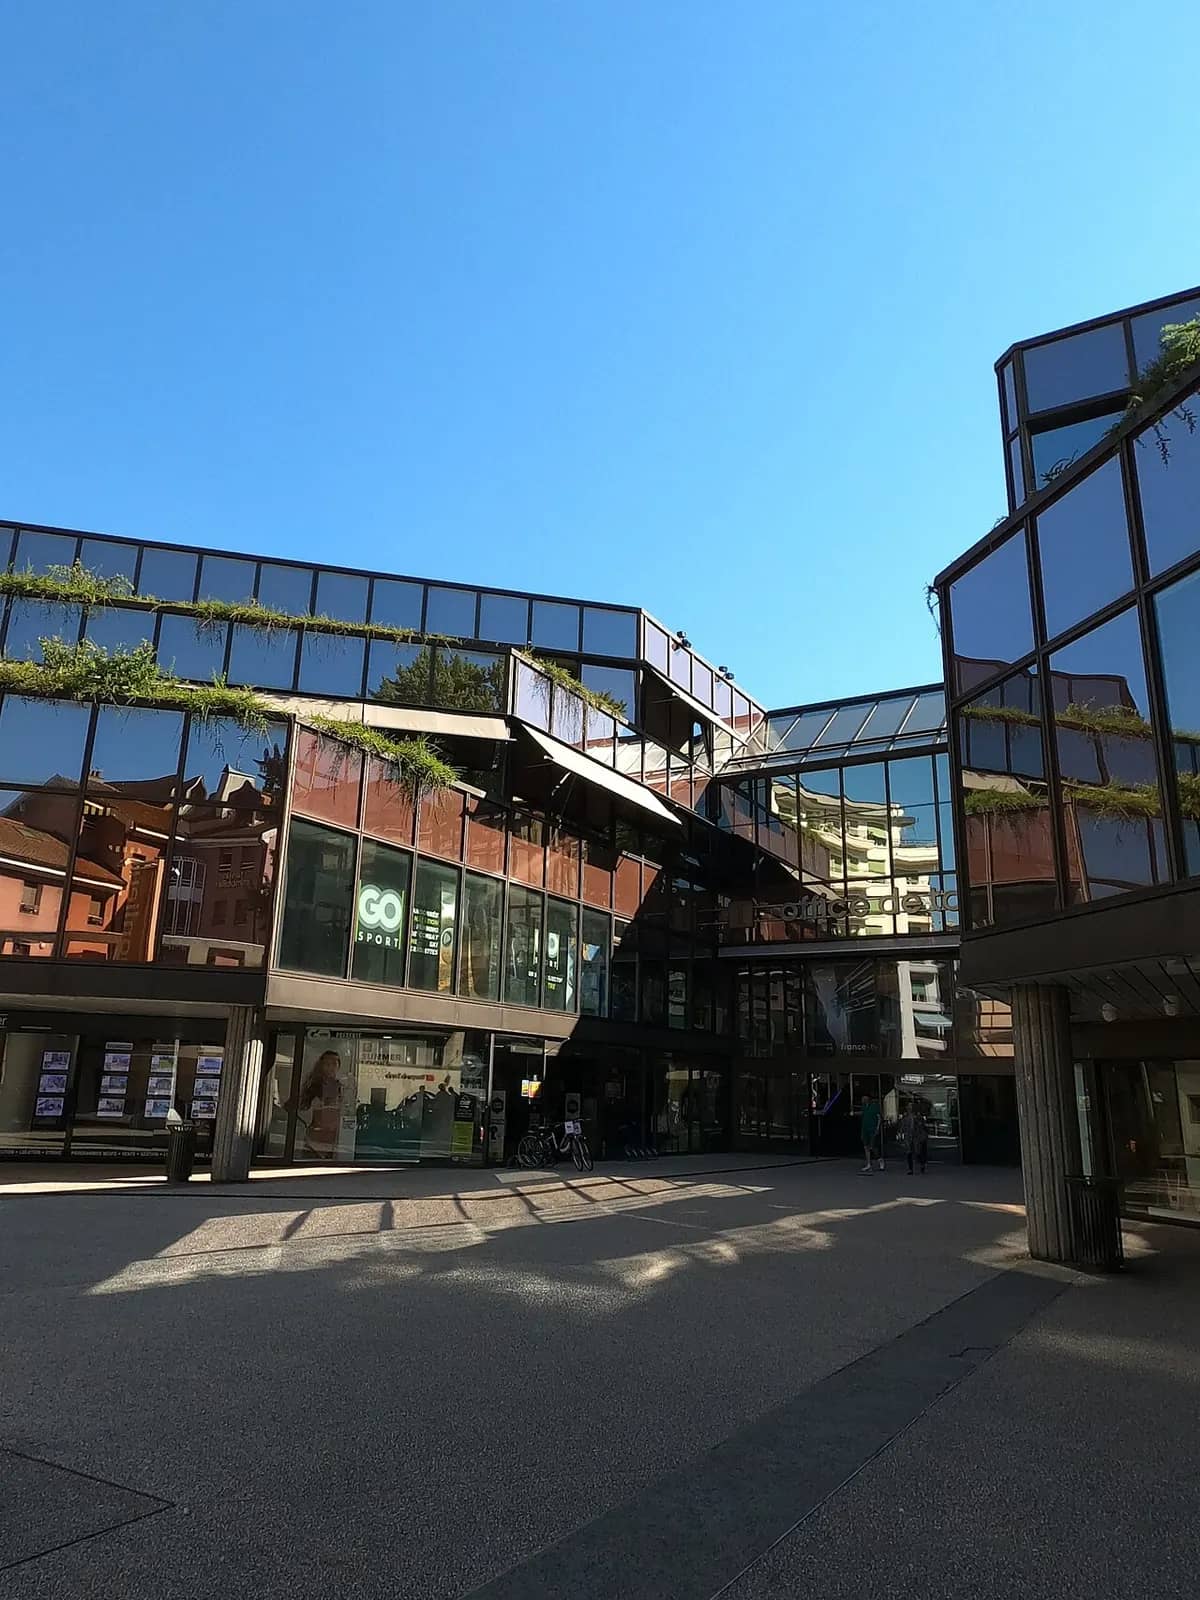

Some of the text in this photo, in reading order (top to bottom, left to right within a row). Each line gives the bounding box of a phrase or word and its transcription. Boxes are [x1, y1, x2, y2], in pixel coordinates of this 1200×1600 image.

[357, 884, 403, 930] GO
[783, 891, 870, 923] office
[879, 887, 922, 916] de
[357, 931, 399, 948] SPORT
